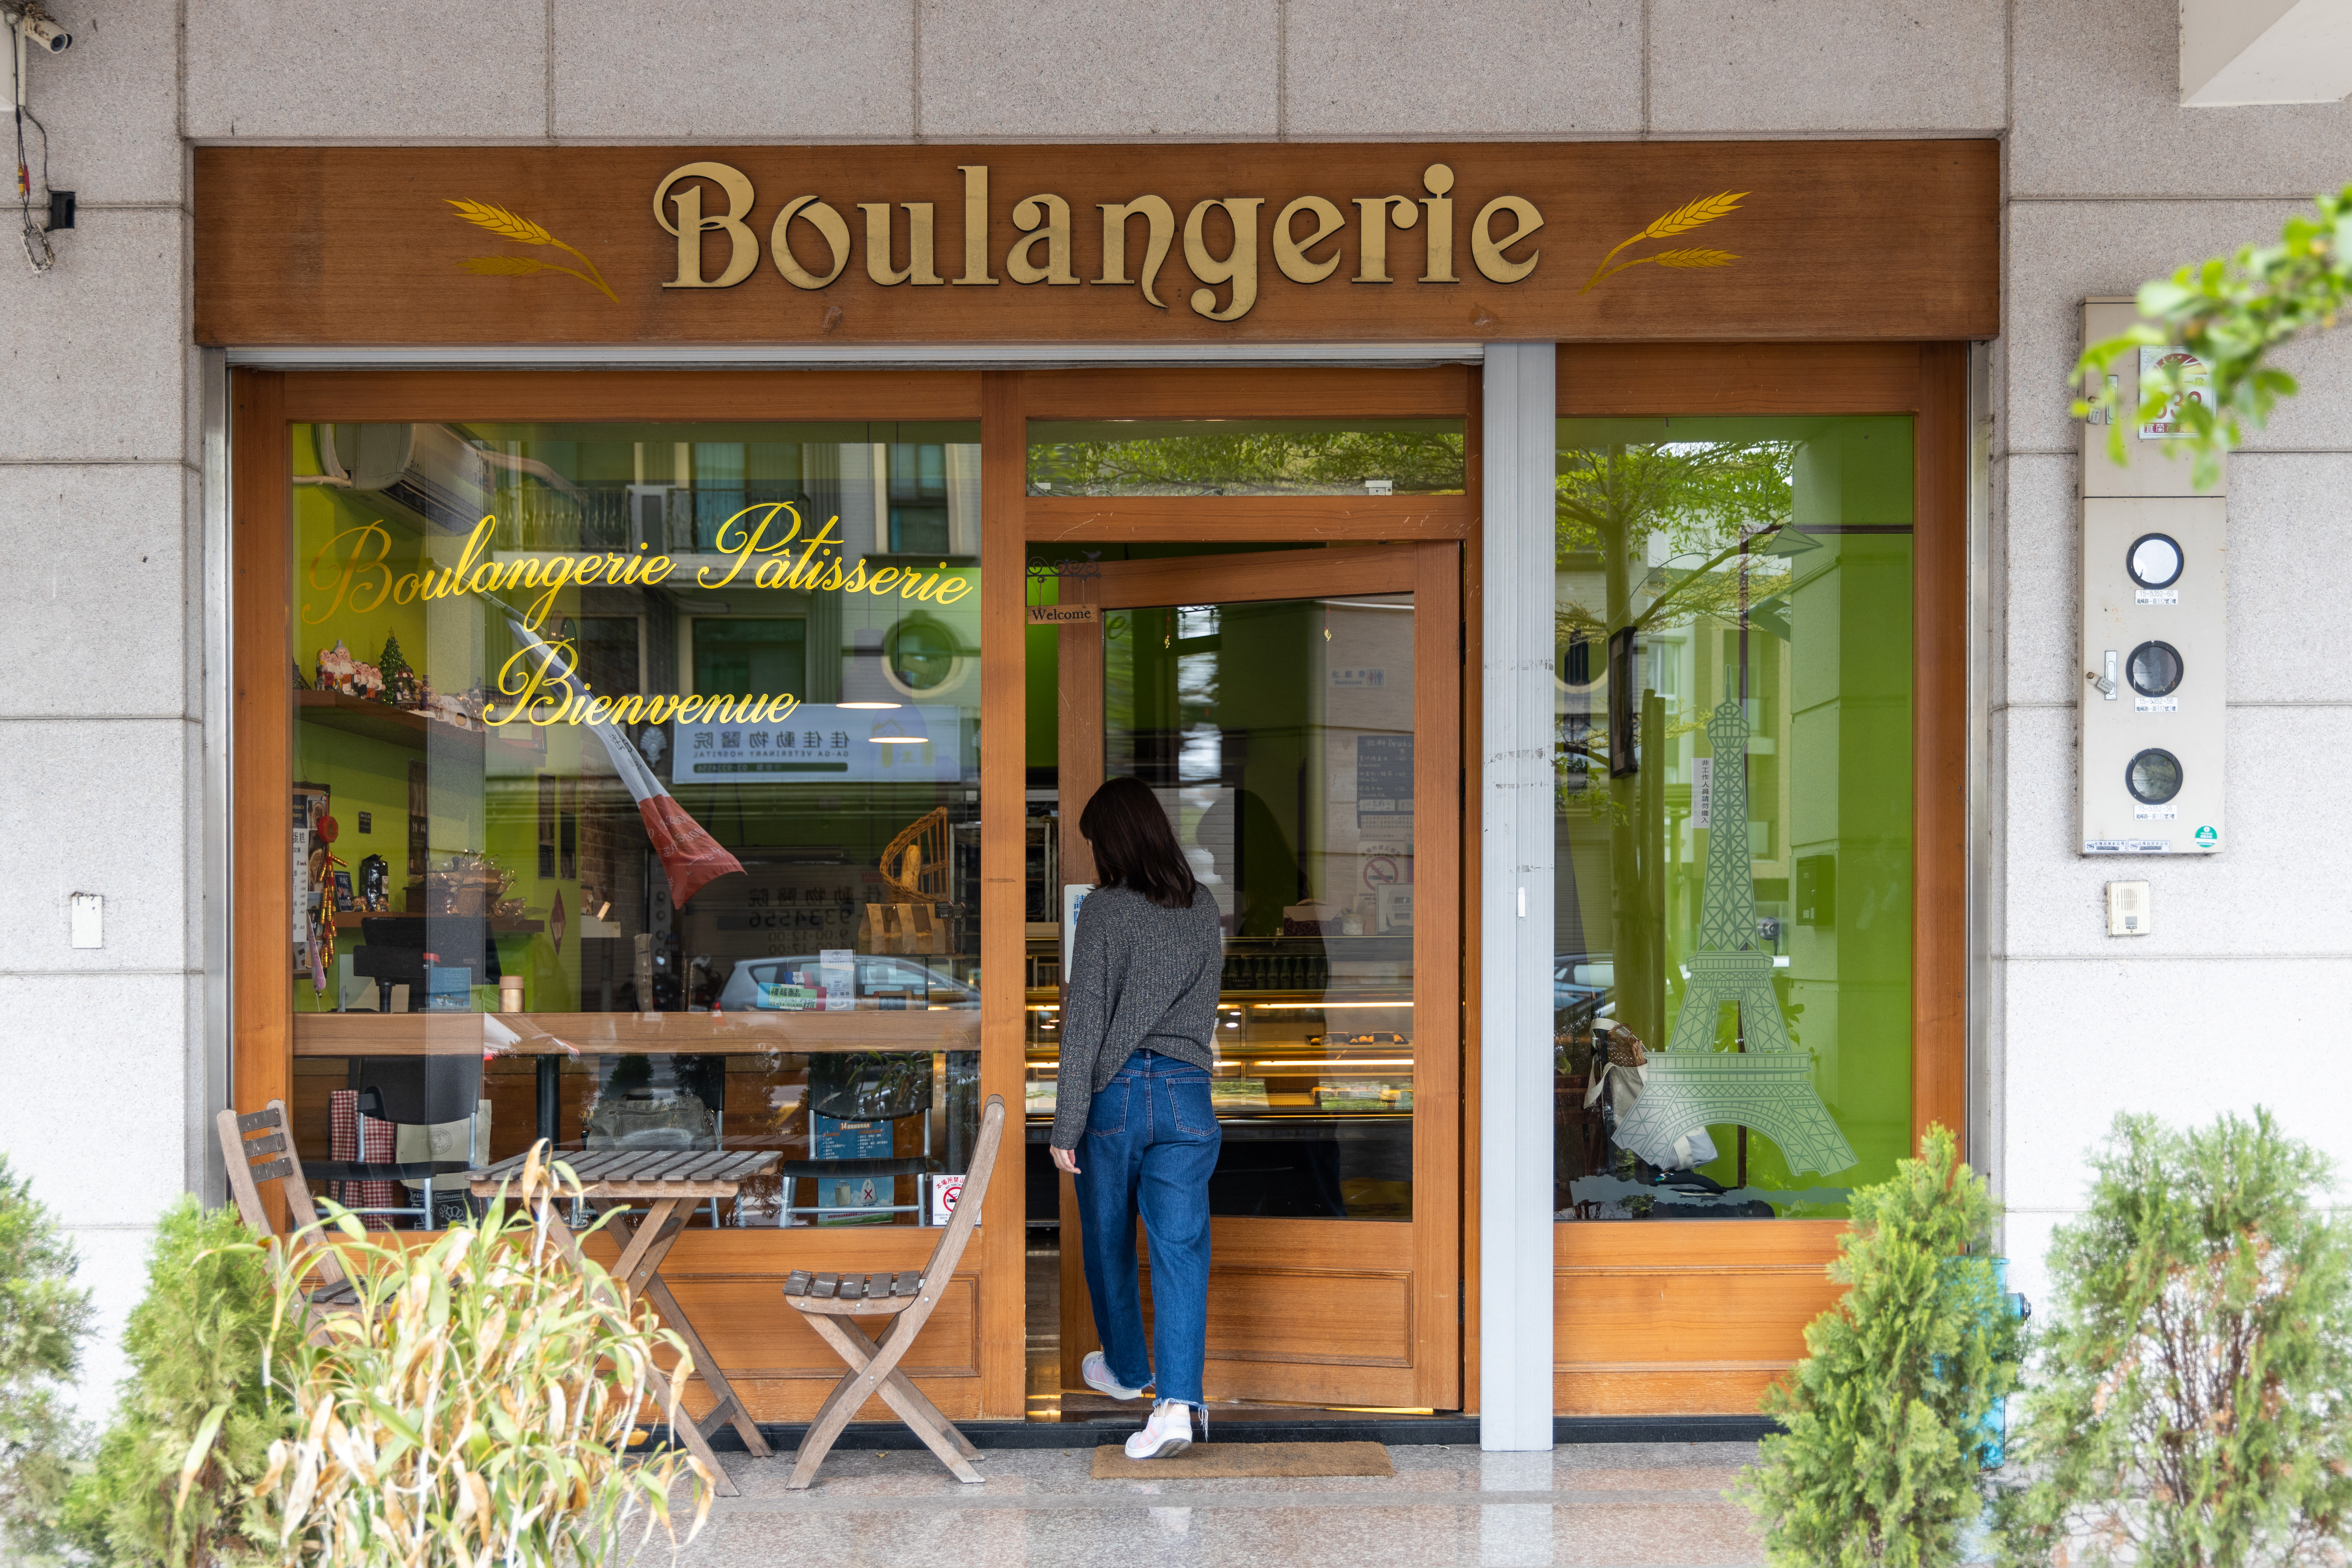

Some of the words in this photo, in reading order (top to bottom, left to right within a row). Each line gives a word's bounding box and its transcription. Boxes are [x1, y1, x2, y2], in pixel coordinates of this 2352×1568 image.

[652, 161, 1545, 321] Boulangerie
[301, 514, 676, 632] Boulangerie
[697, 501, 973, 605] Pâtisserie
[1032, 608, 1091, 621] Welcome
[482, 638, 800, 727] Bienvenue
[1701, 759, 1709, 824] 非工作人員請勿進入
[293, 832, 306, 844] 蛋糕
[771, 988, 801, 997] 惜福商品
[800, 997, 816, 1008] 7折
[936, 1176, 965, 1189] 本場所禁止
